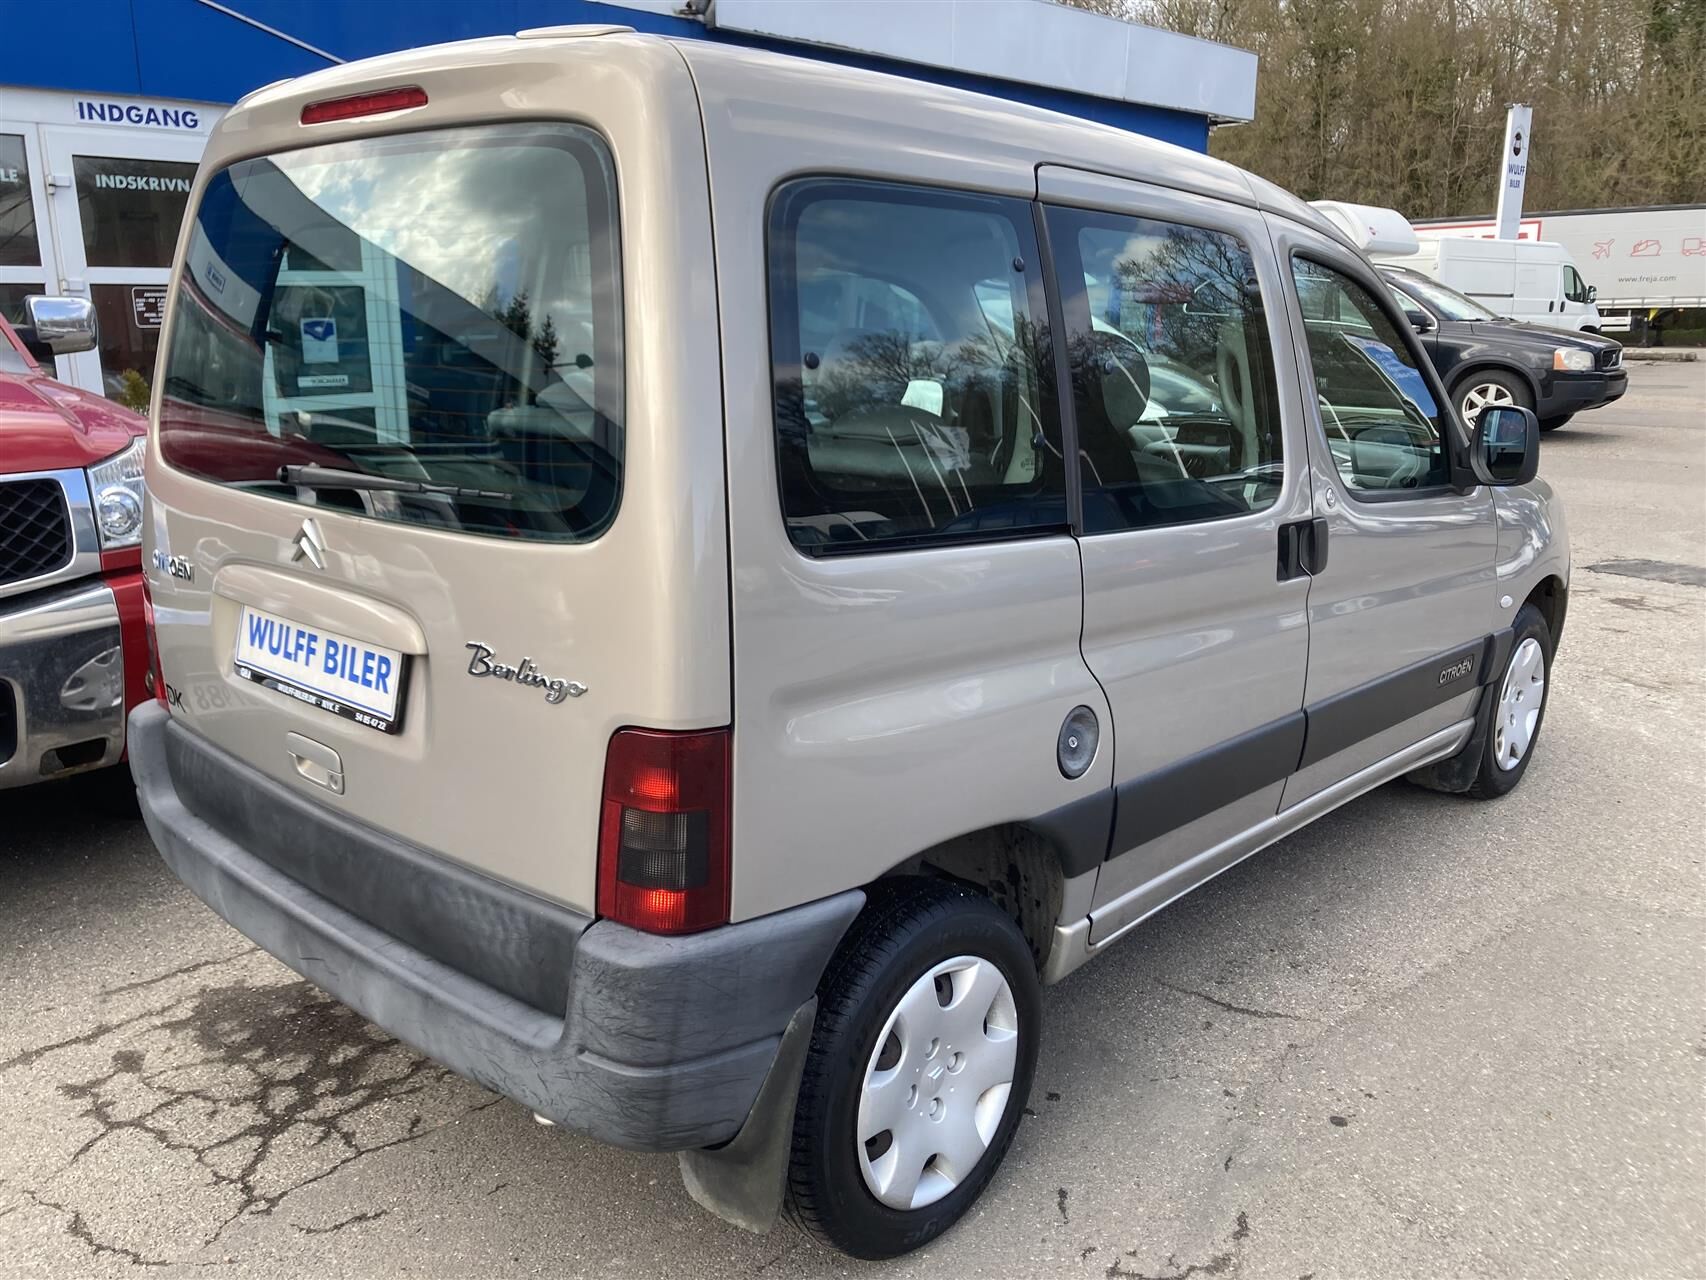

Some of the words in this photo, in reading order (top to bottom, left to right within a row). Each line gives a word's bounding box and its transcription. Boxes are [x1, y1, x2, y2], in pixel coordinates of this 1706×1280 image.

[77, 101, 199, 129] INDGANG
[1508, 163, 1526, 176] WULFF
[1617, 274, 1678, 284] www.freja.com
[248, 613, 319, 667] WULFF
[322, 638, 393, 695] BILER
[465, 640, 589, 704] Berlingo
[1439, 656, 1474, 684] CITROËN
[165, 683, 187, 714] DK
